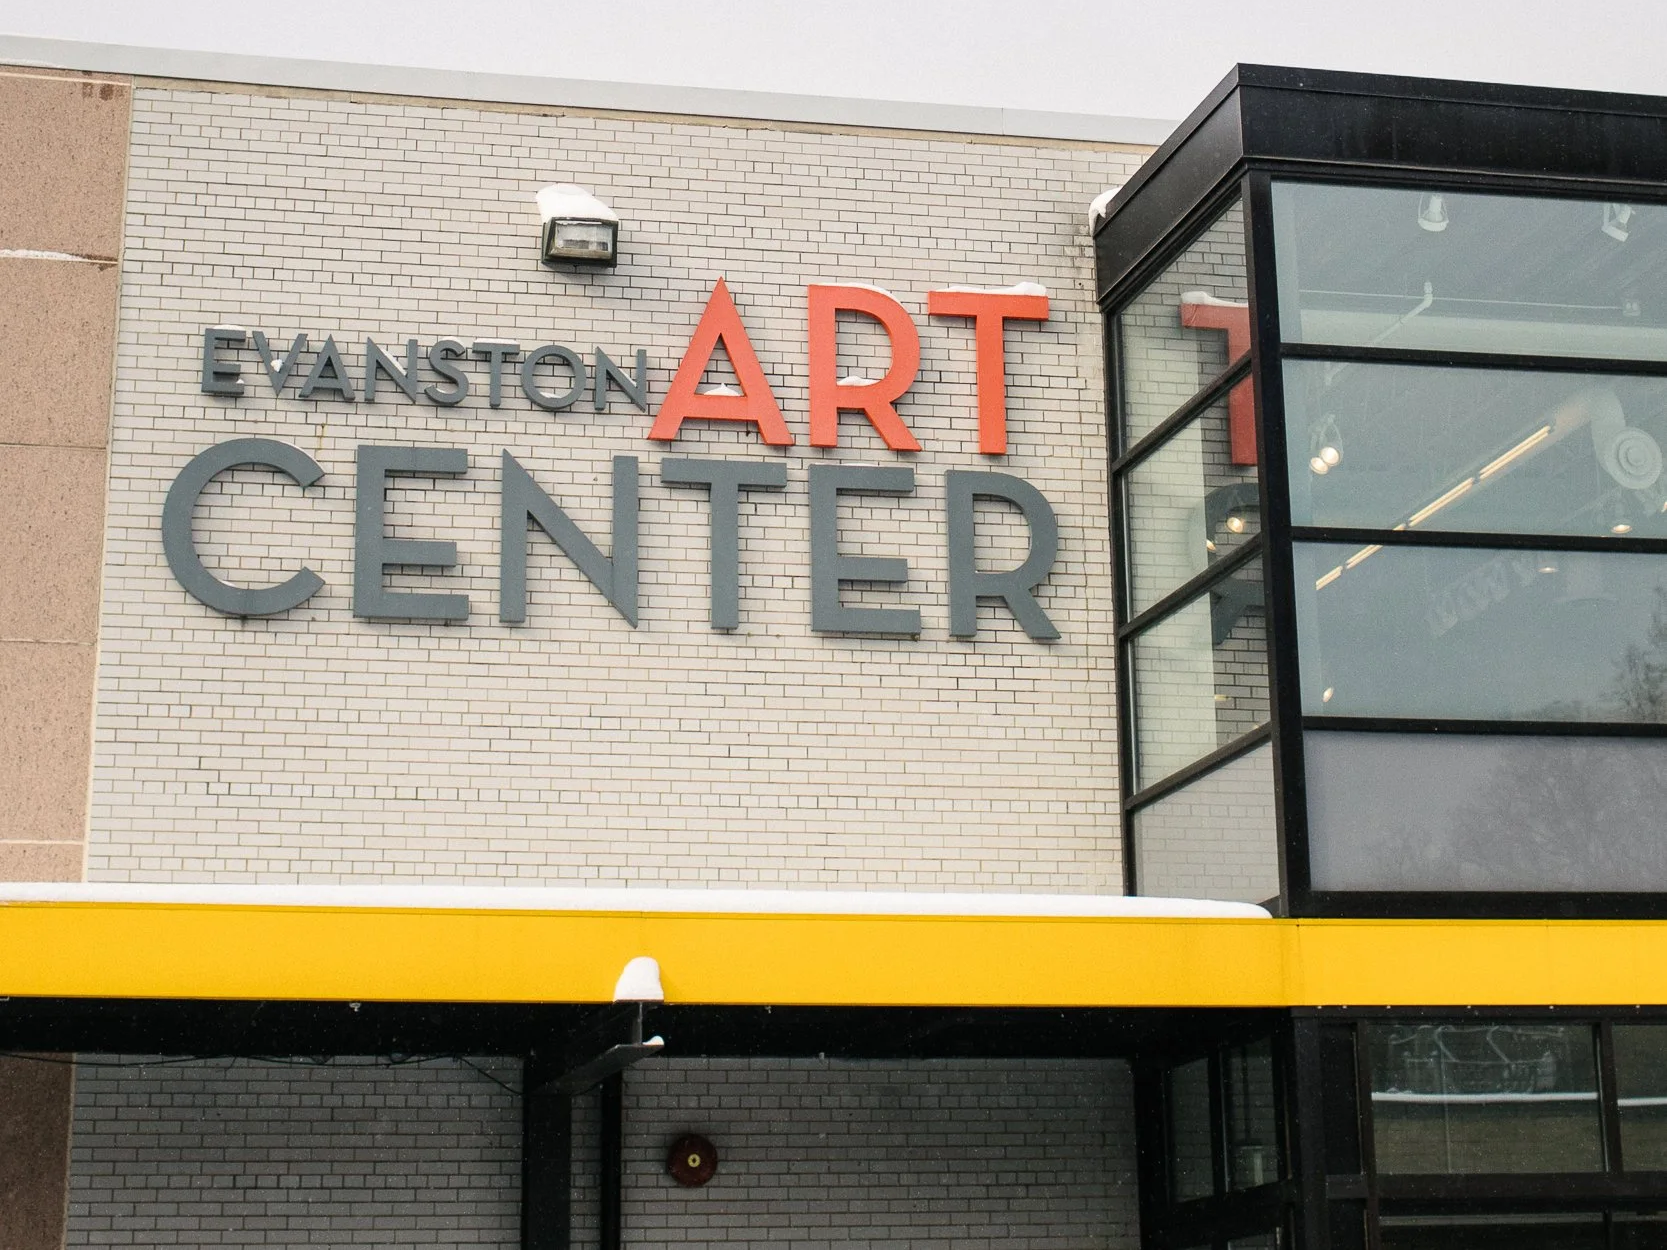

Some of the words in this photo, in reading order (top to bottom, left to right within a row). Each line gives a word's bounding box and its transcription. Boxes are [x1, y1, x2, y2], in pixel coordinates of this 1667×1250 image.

[200, 327, 648, 414] EVANSTON
[647, 276, 1051, 456] ART
[161, 437, 1061, 641] CENTER
